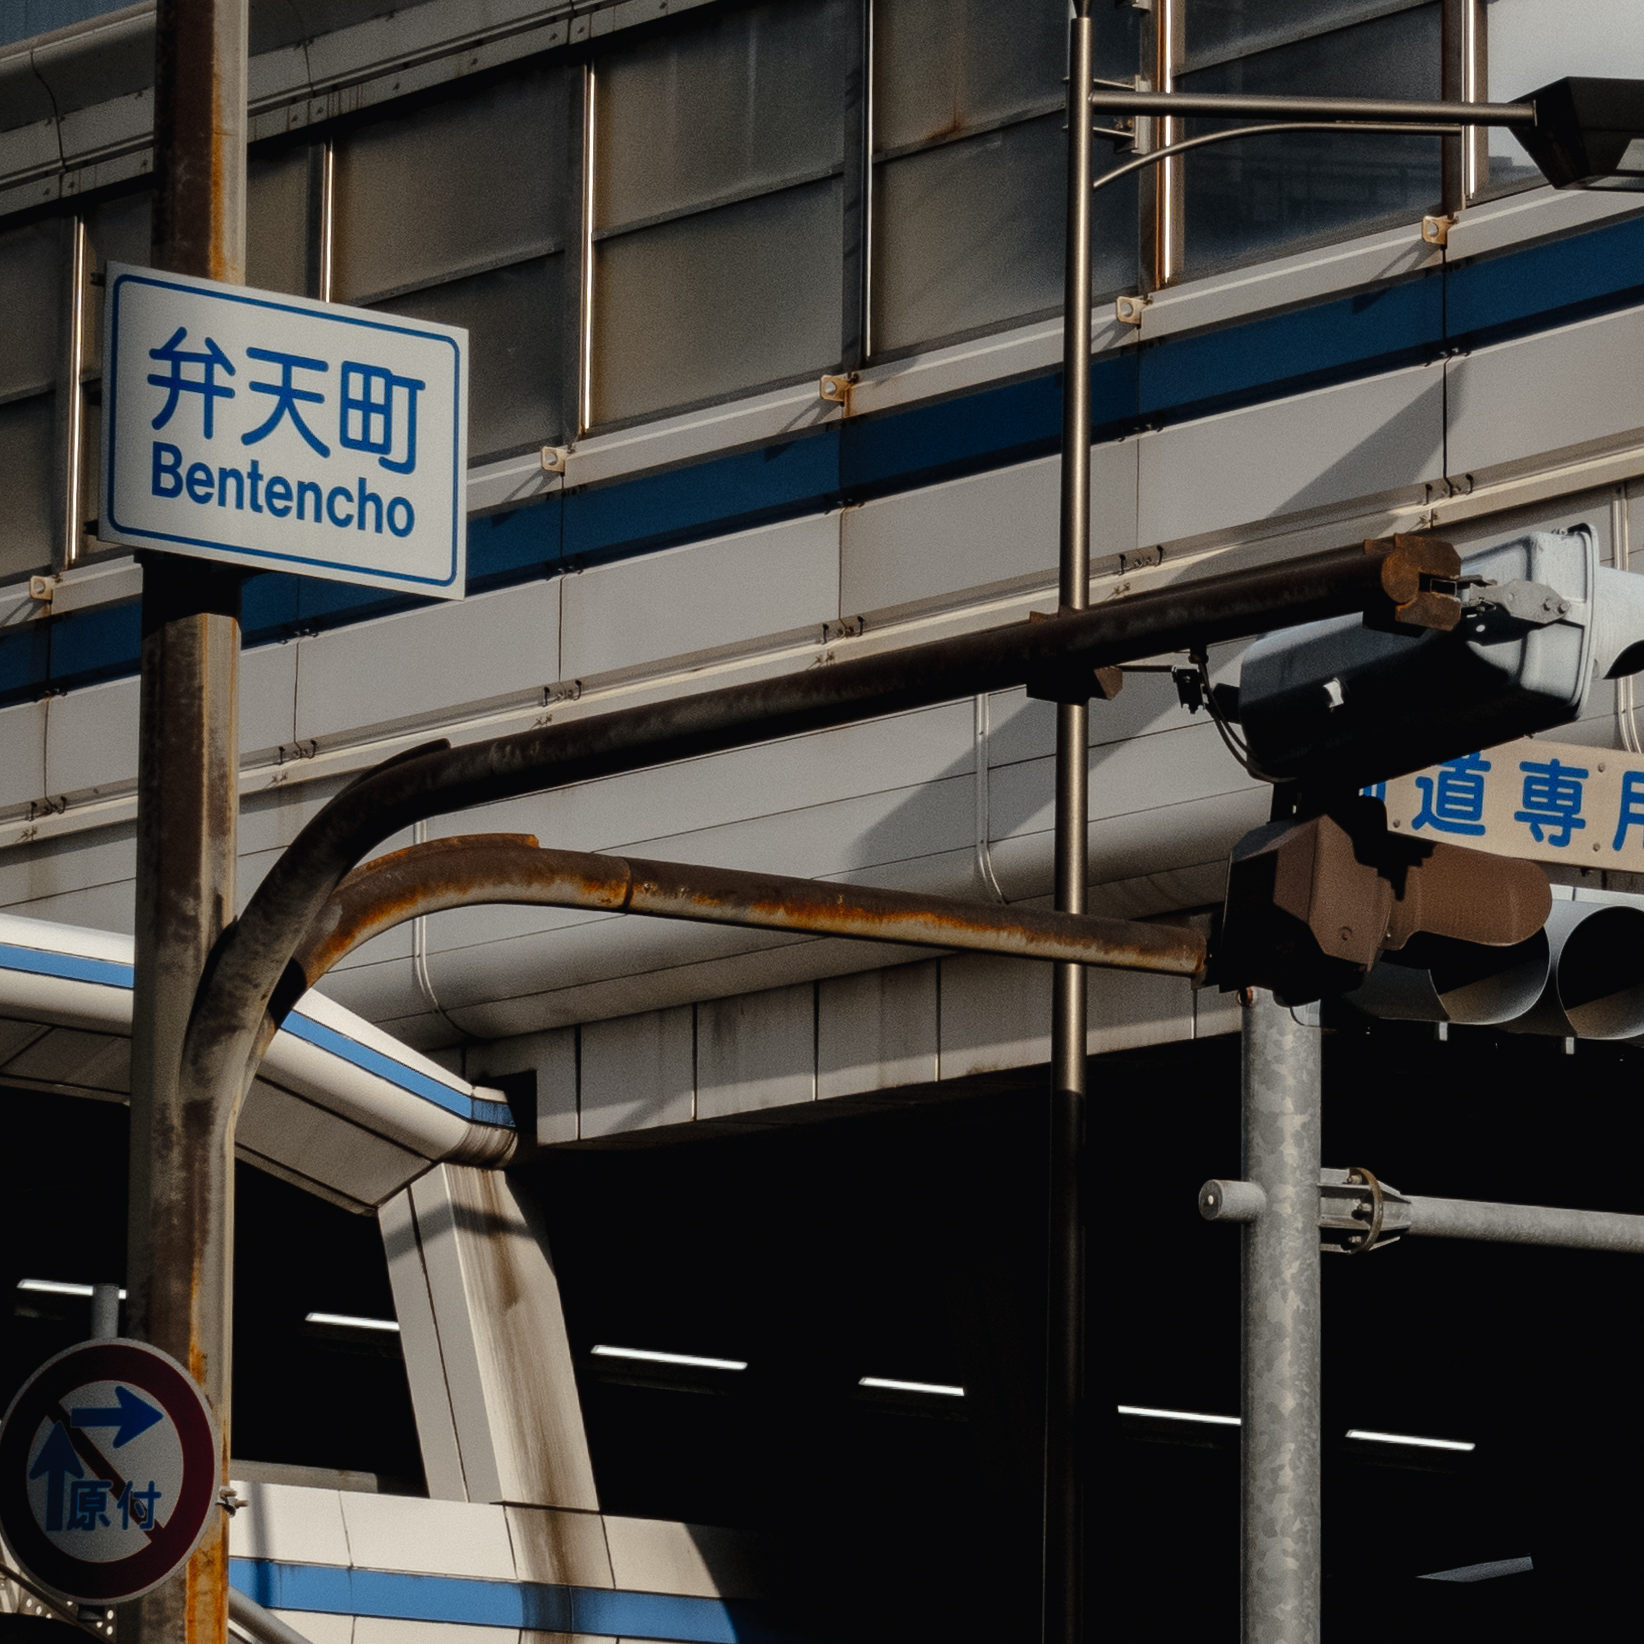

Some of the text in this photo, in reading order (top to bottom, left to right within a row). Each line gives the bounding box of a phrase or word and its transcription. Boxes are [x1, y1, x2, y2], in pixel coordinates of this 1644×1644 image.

[147, 326, 426, 475] 弁天町
[151, 440, 415, 538] Bentencho
[66, 1479, 162, 1531] 原付
